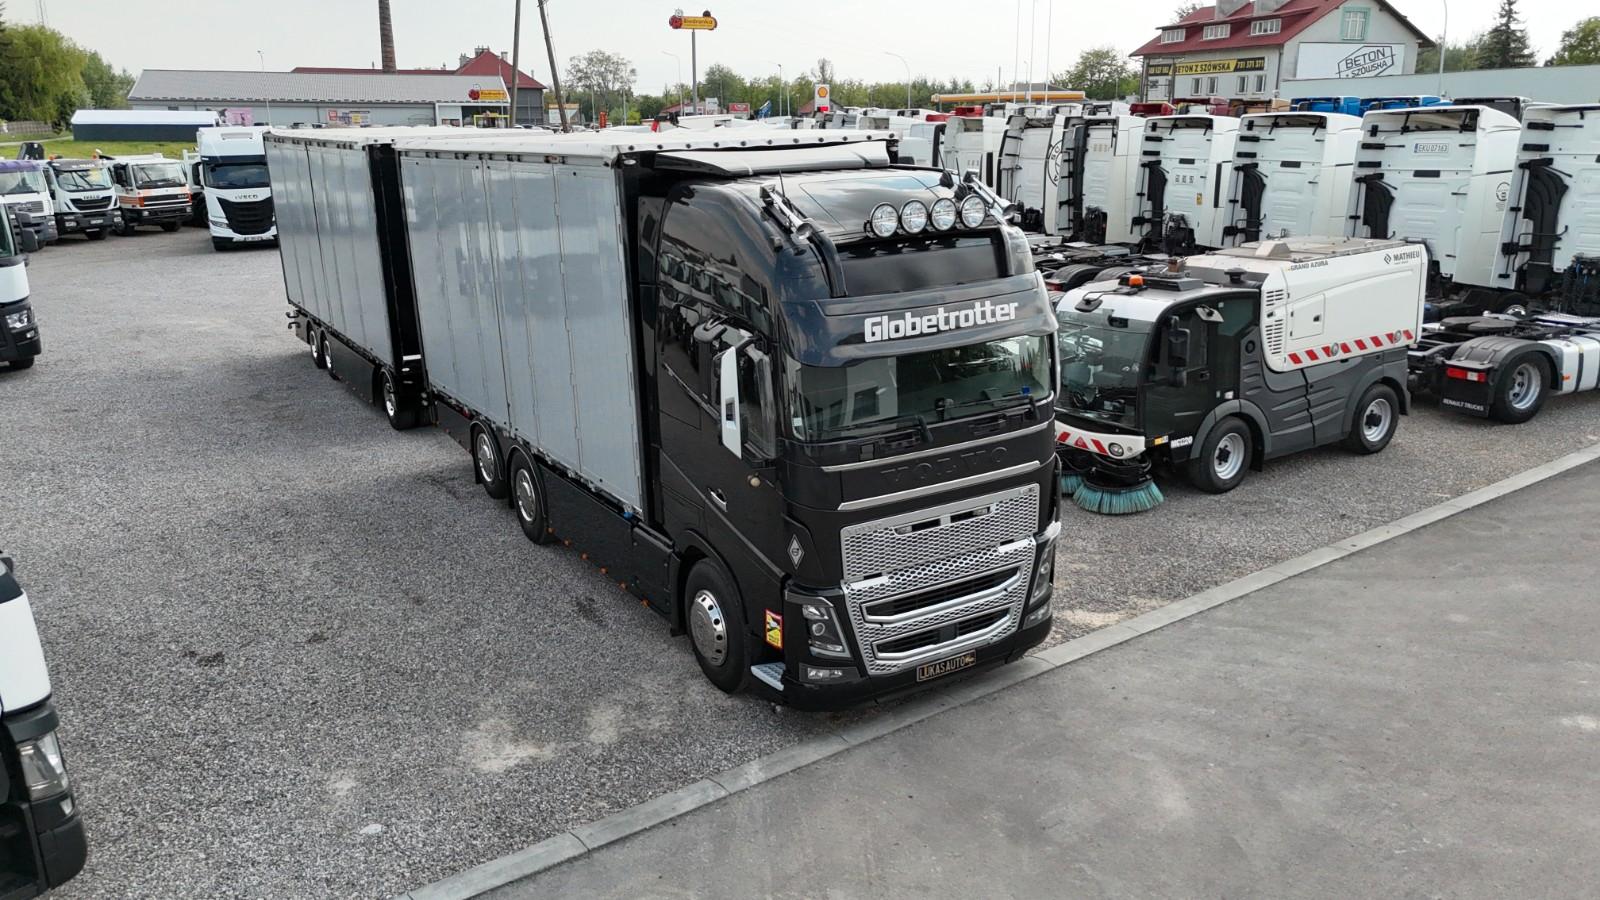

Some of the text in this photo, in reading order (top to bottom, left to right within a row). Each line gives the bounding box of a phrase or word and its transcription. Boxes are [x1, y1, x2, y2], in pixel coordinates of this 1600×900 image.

[1345, 48, 1386, 69] BETON
[1175, 64, 1194, 73] ETON
[1393, 251, 1420, 262] MATHIEU
[864, 301, 1019, 343] Globetrotter
